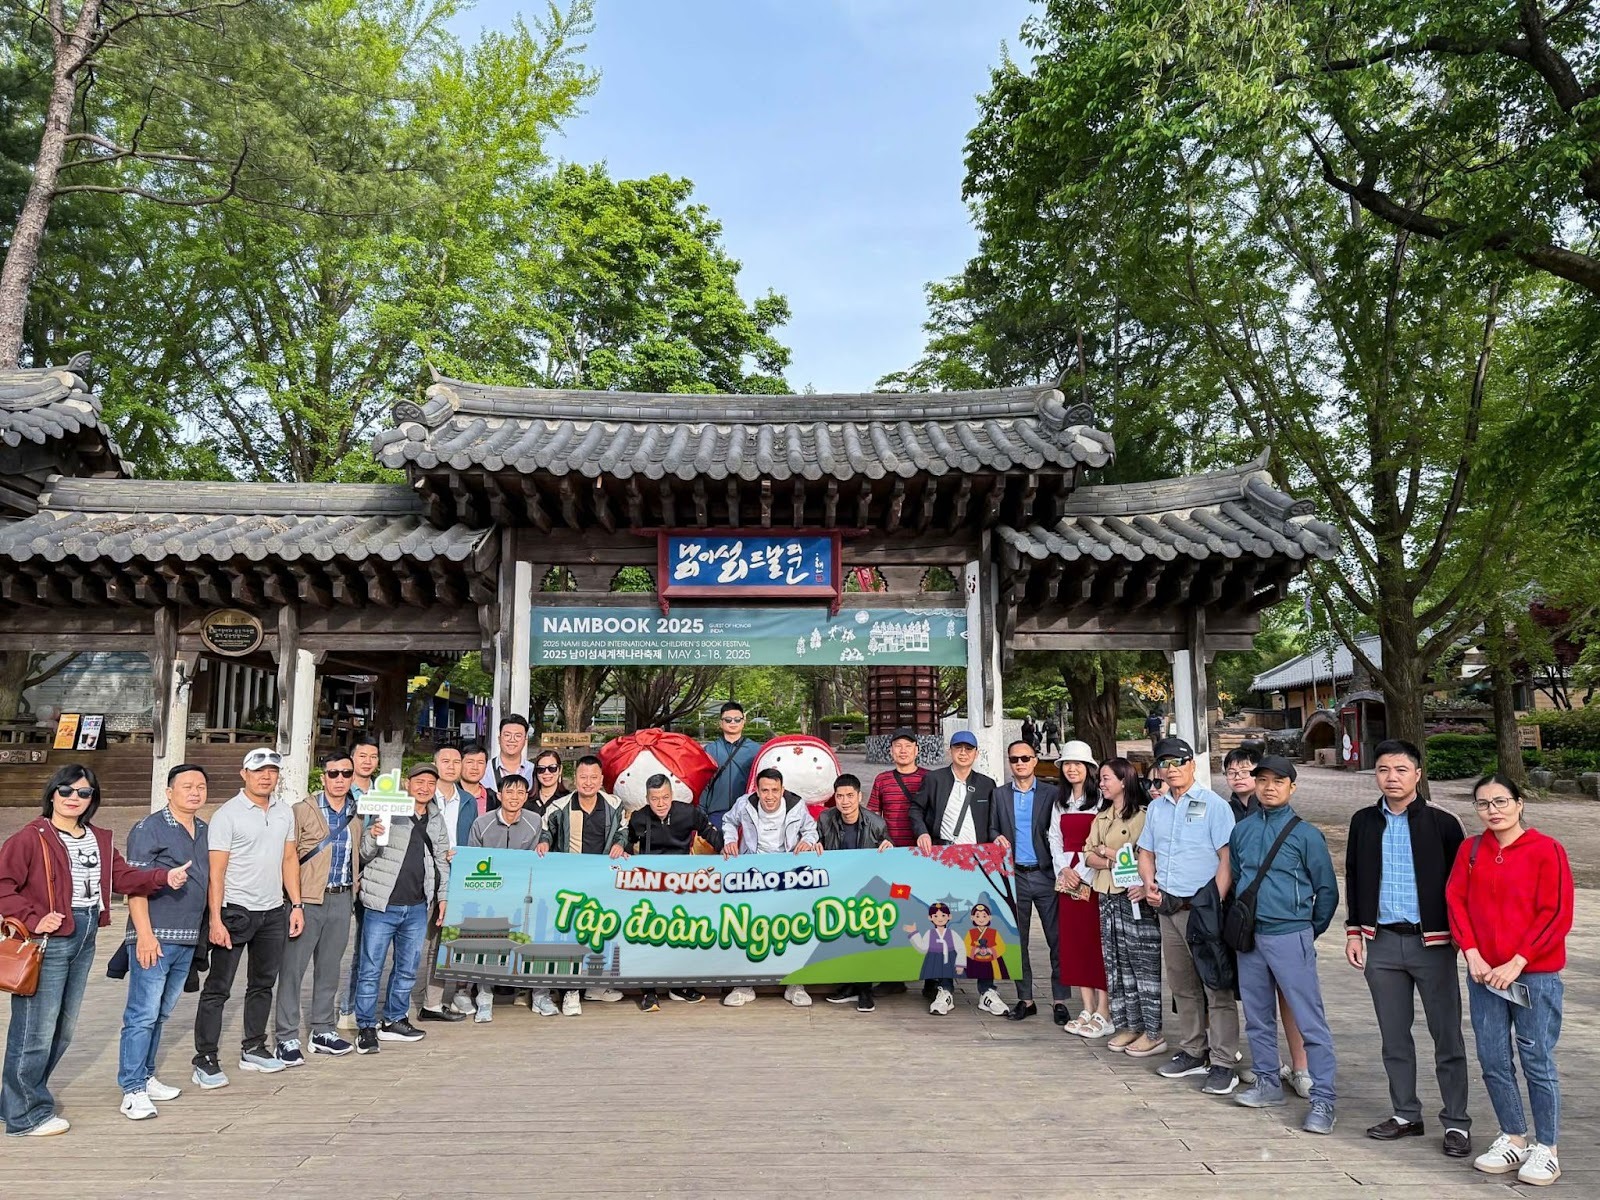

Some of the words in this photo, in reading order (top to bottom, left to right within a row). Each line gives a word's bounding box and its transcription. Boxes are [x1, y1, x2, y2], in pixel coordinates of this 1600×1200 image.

[543, 617, 650, 633] NAMBOOK
[657, 618, 704, 633] 2025
[543, 650, 567, 659] 2025
[667, 650, 692, 659] MAY
[726, 650, 751, 659] 2025
[616, 867, 661, 889] HÀN
[663, 867, 721, 893] QUỐC
[724, 867, 781, 892] CHÀO
[556, 891, 619, 951] Tập
[624, 900, 716, 950] đoàn
[719, 904, 811, 961] Ngọc
[816, 895, 898, 944] Diệp
